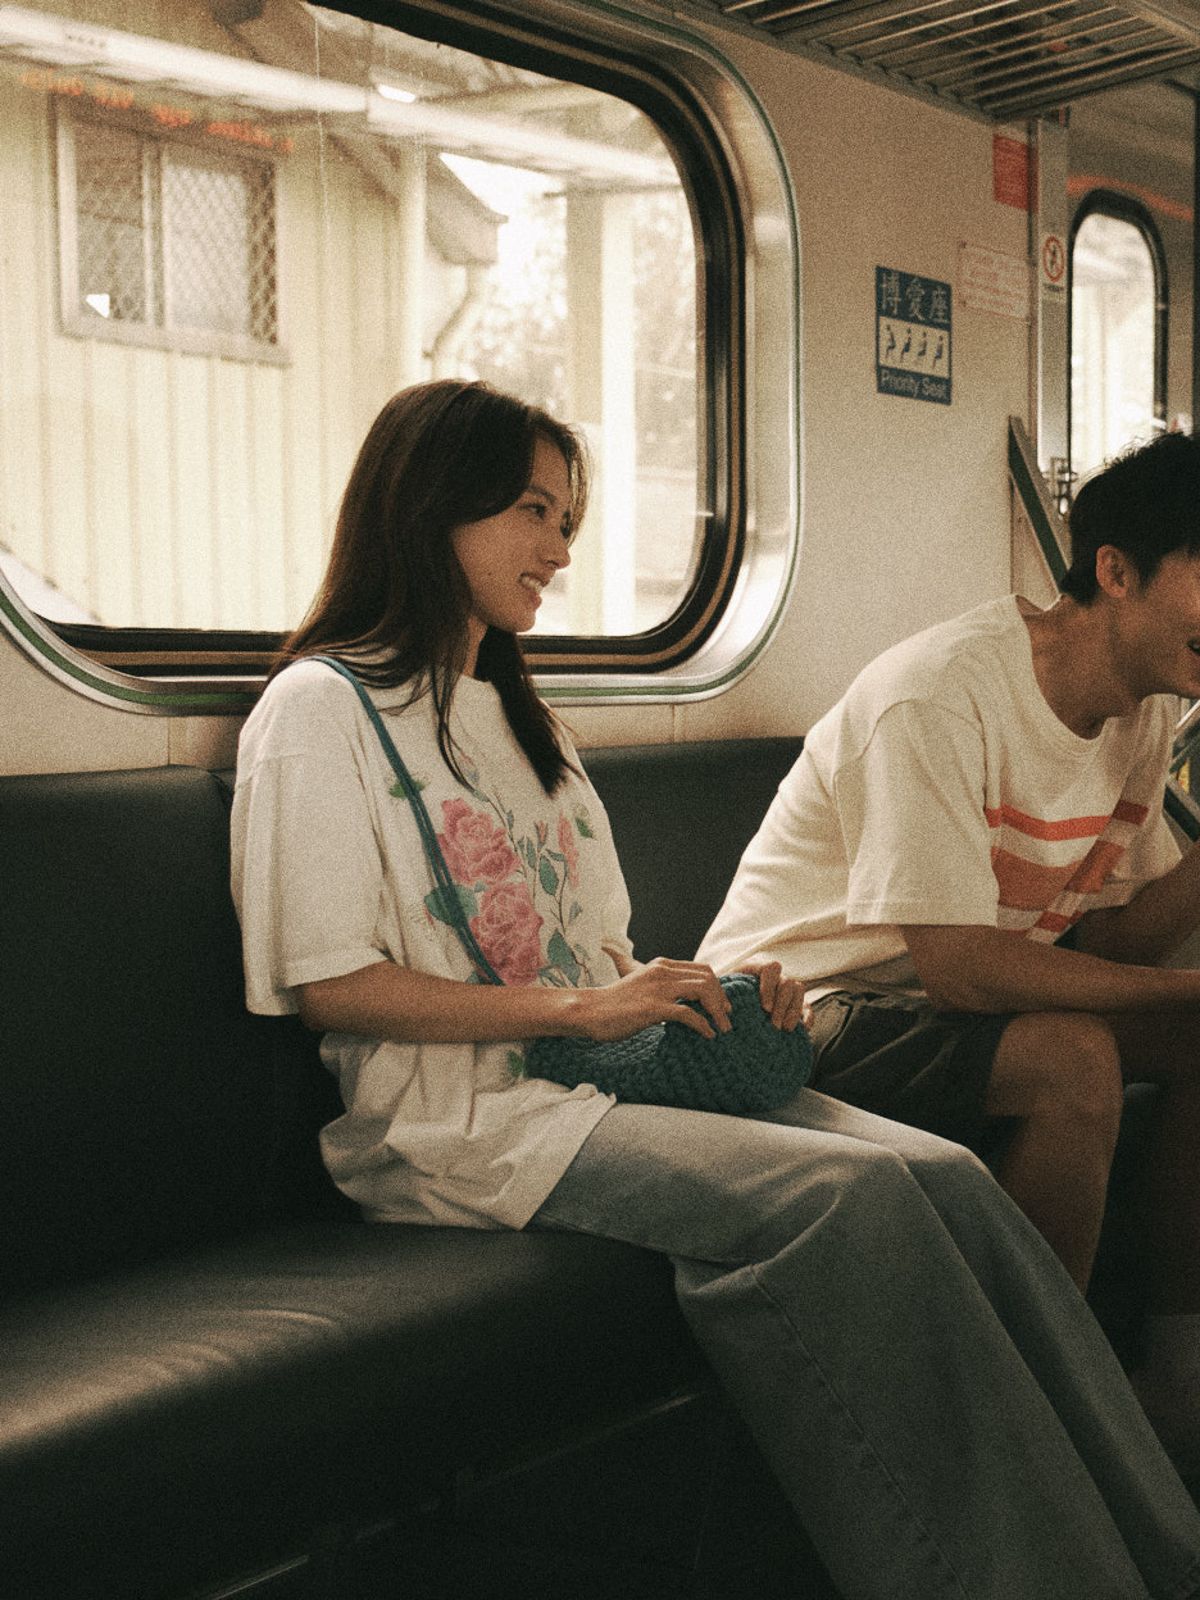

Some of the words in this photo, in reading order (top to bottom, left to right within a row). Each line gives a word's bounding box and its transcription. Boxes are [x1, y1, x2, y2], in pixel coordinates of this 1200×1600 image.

[881, 271, 949, 324] 博愛座
[881, 369, 921, 398] Priority
[922, 376, 948, 399] Seat
